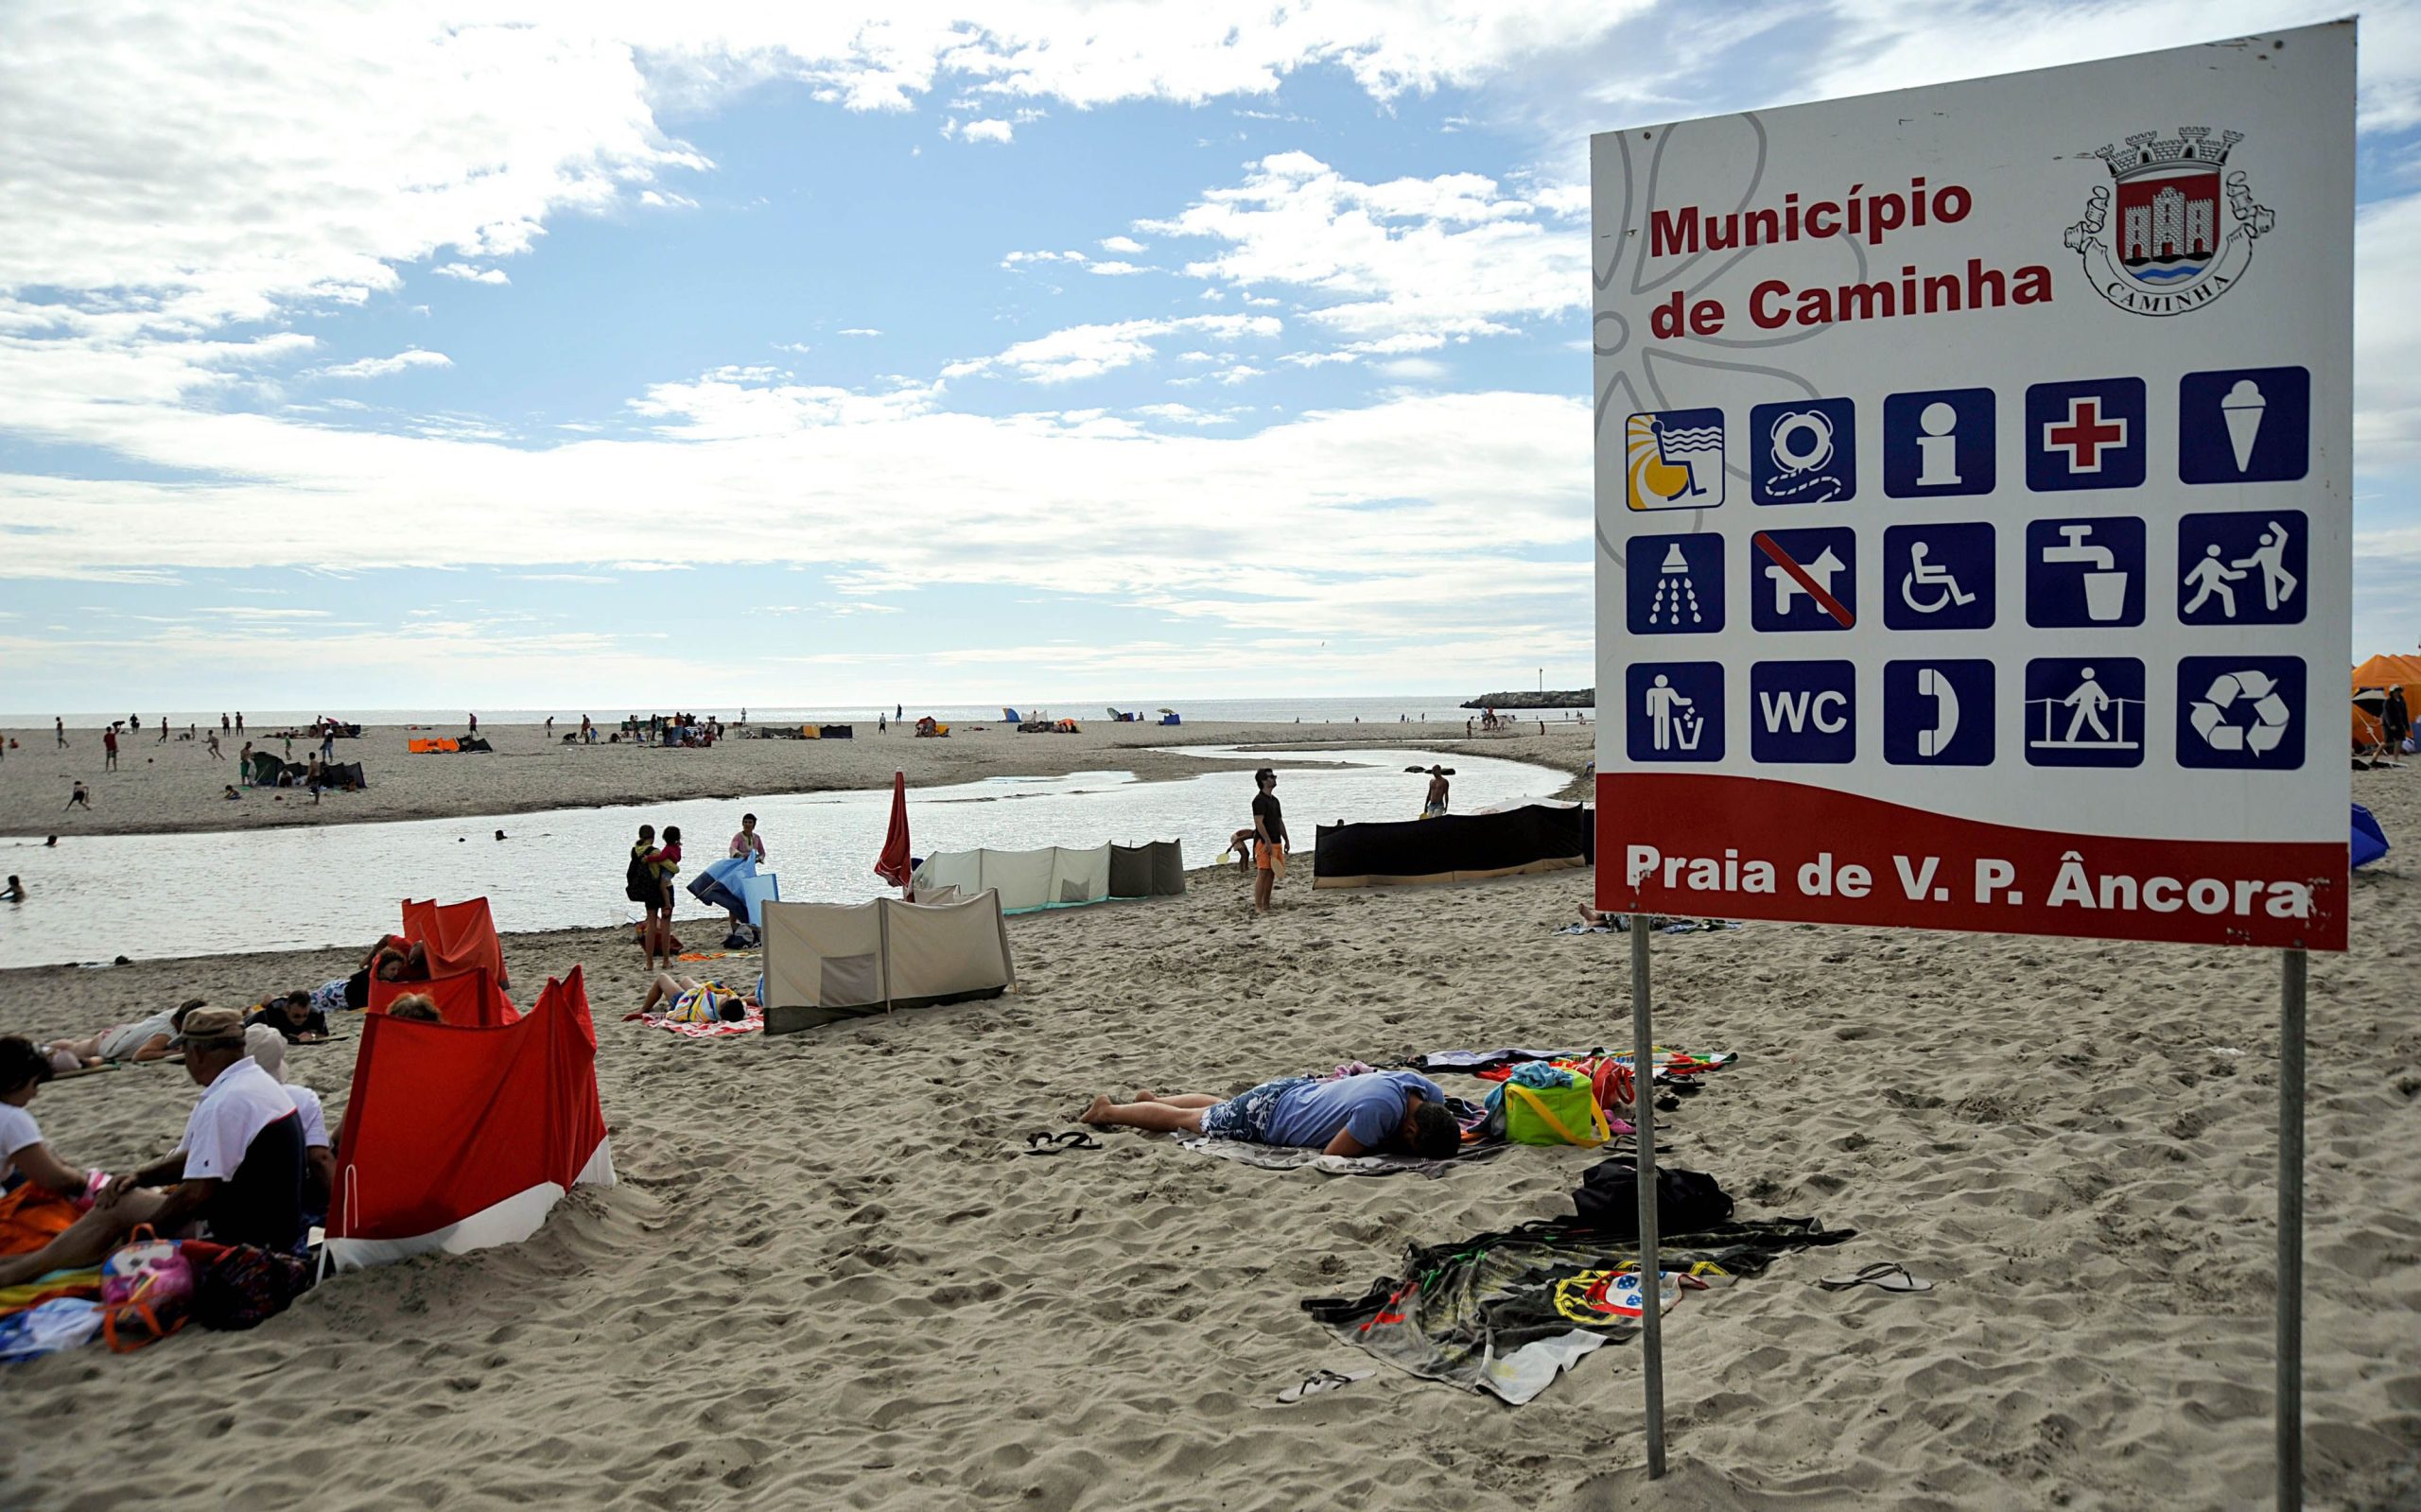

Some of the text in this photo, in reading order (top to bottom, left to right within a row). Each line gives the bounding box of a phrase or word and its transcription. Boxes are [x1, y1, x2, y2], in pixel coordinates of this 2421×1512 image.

[1651, 178, 1972, 257] Município
[1651, 259, 2052, 339] de Caminha
[2107, 275, 2230, 312] CAMINHA
[1759, 690, 1847, 734] WC
[1627, 844, 2309, 919] Praia de V. P. Âncora
